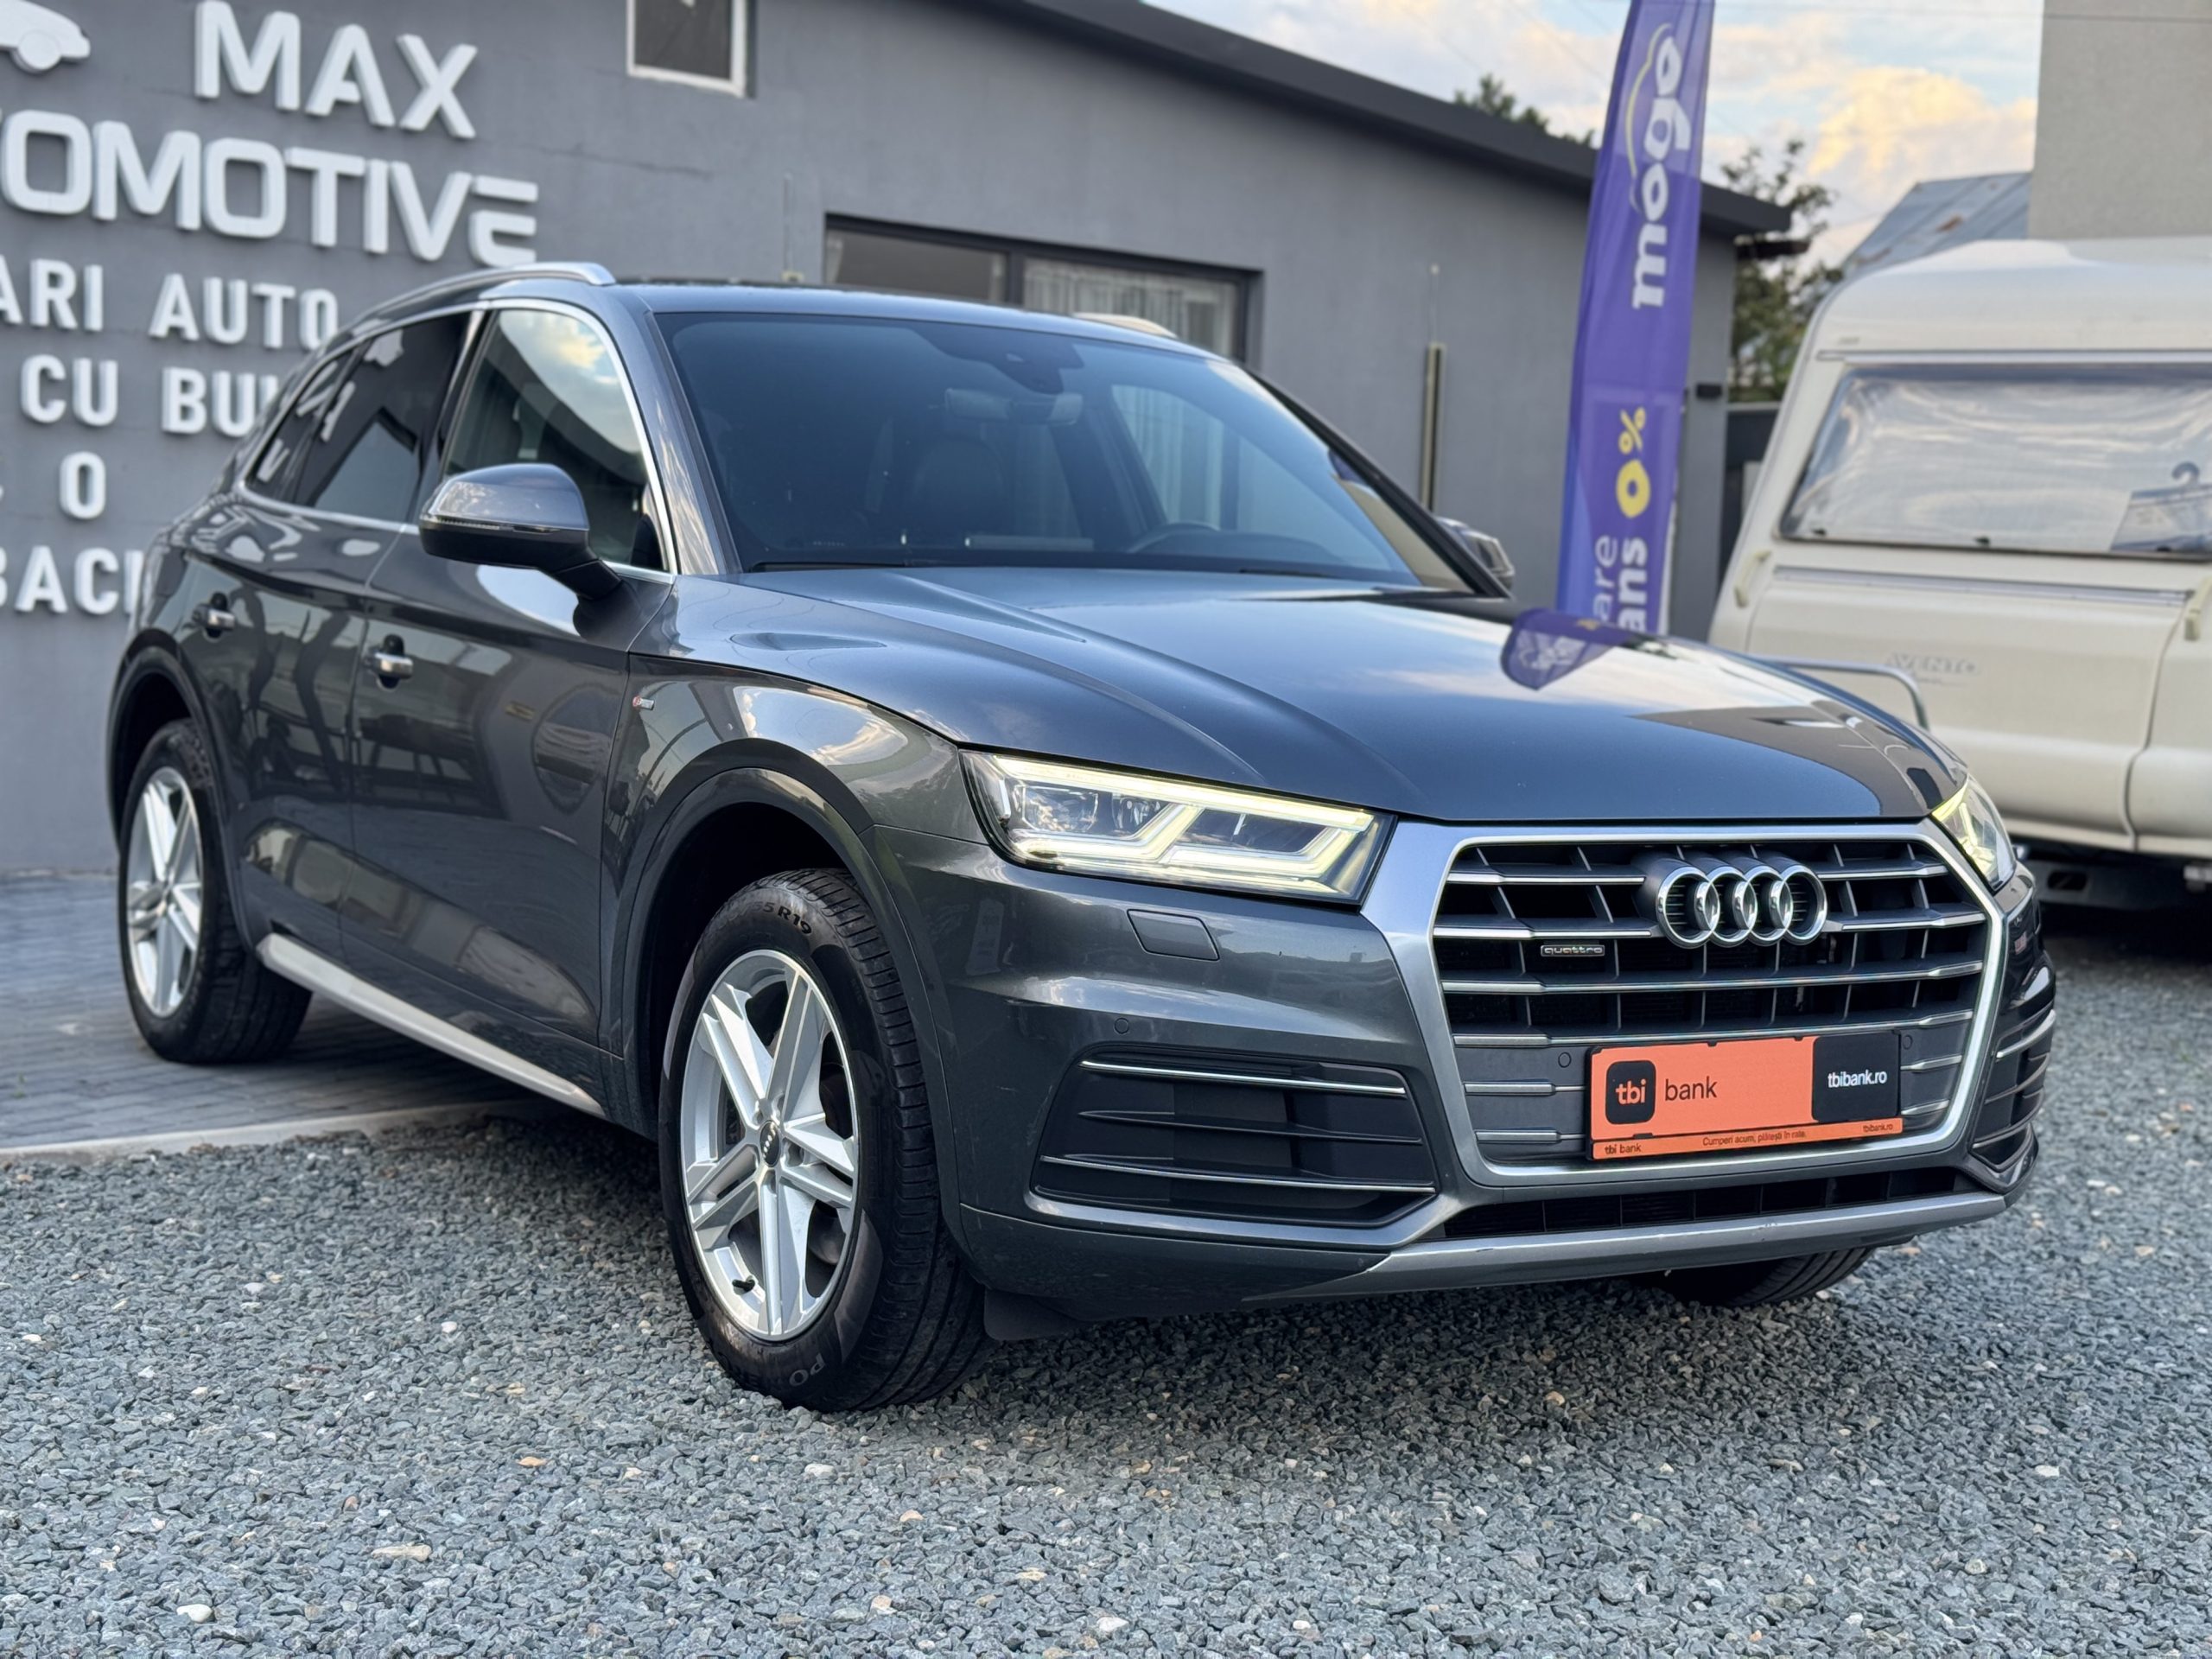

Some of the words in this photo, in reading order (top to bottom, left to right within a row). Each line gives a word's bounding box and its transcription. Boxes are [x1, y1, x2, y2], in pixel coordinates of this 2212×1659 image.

[194, 0, 478, 139] MAX
[0, 106, 538, 268] OMOTIVE
[1632, 36, 1692, 308] mogo
[148, 273, 339, 351] AUTO
[21, 353, 119, 426] CU
[1543, 945, 1603, 956] quattro
[1615, 1077, 1647, 1105] tbi
[1664, 1075, 1718, 1102] bank
[1827, 1068, 1888, 1089] tbibank.ro
[1604, 1143, 1618, 1155] tbi
[1619, 1142, 1642, 1154] bank
